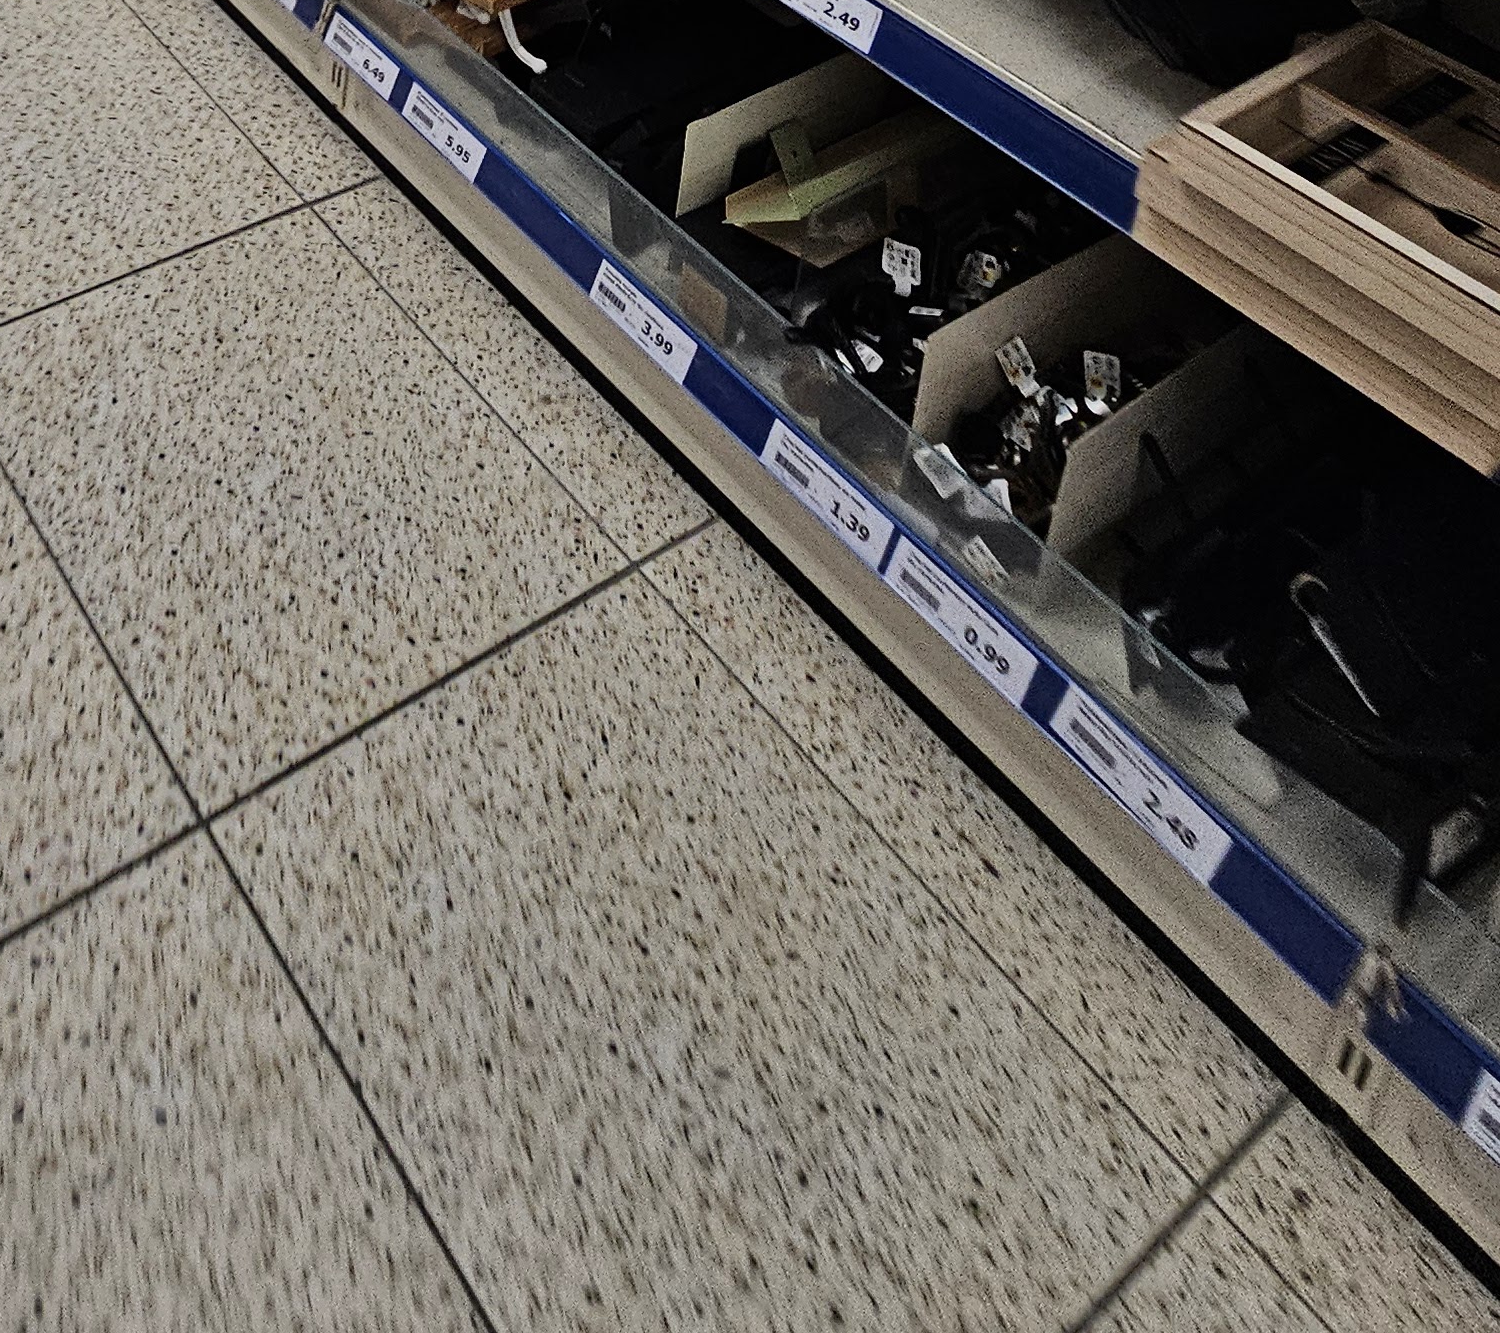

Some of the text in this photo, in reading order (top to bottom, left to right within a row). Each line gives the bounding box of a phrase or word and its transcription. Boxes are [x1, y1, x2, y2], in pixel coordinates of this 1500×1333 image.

[823, 0, 860, 32] 2.49
[362, 58, 386, 83] 6.49
[445, 134, 472, 164] 5.95
[639, 318, 675, 356] 3.99
[830, 498, 871, 543] 1.39
[963, 626, 1011, 676] 0.99
